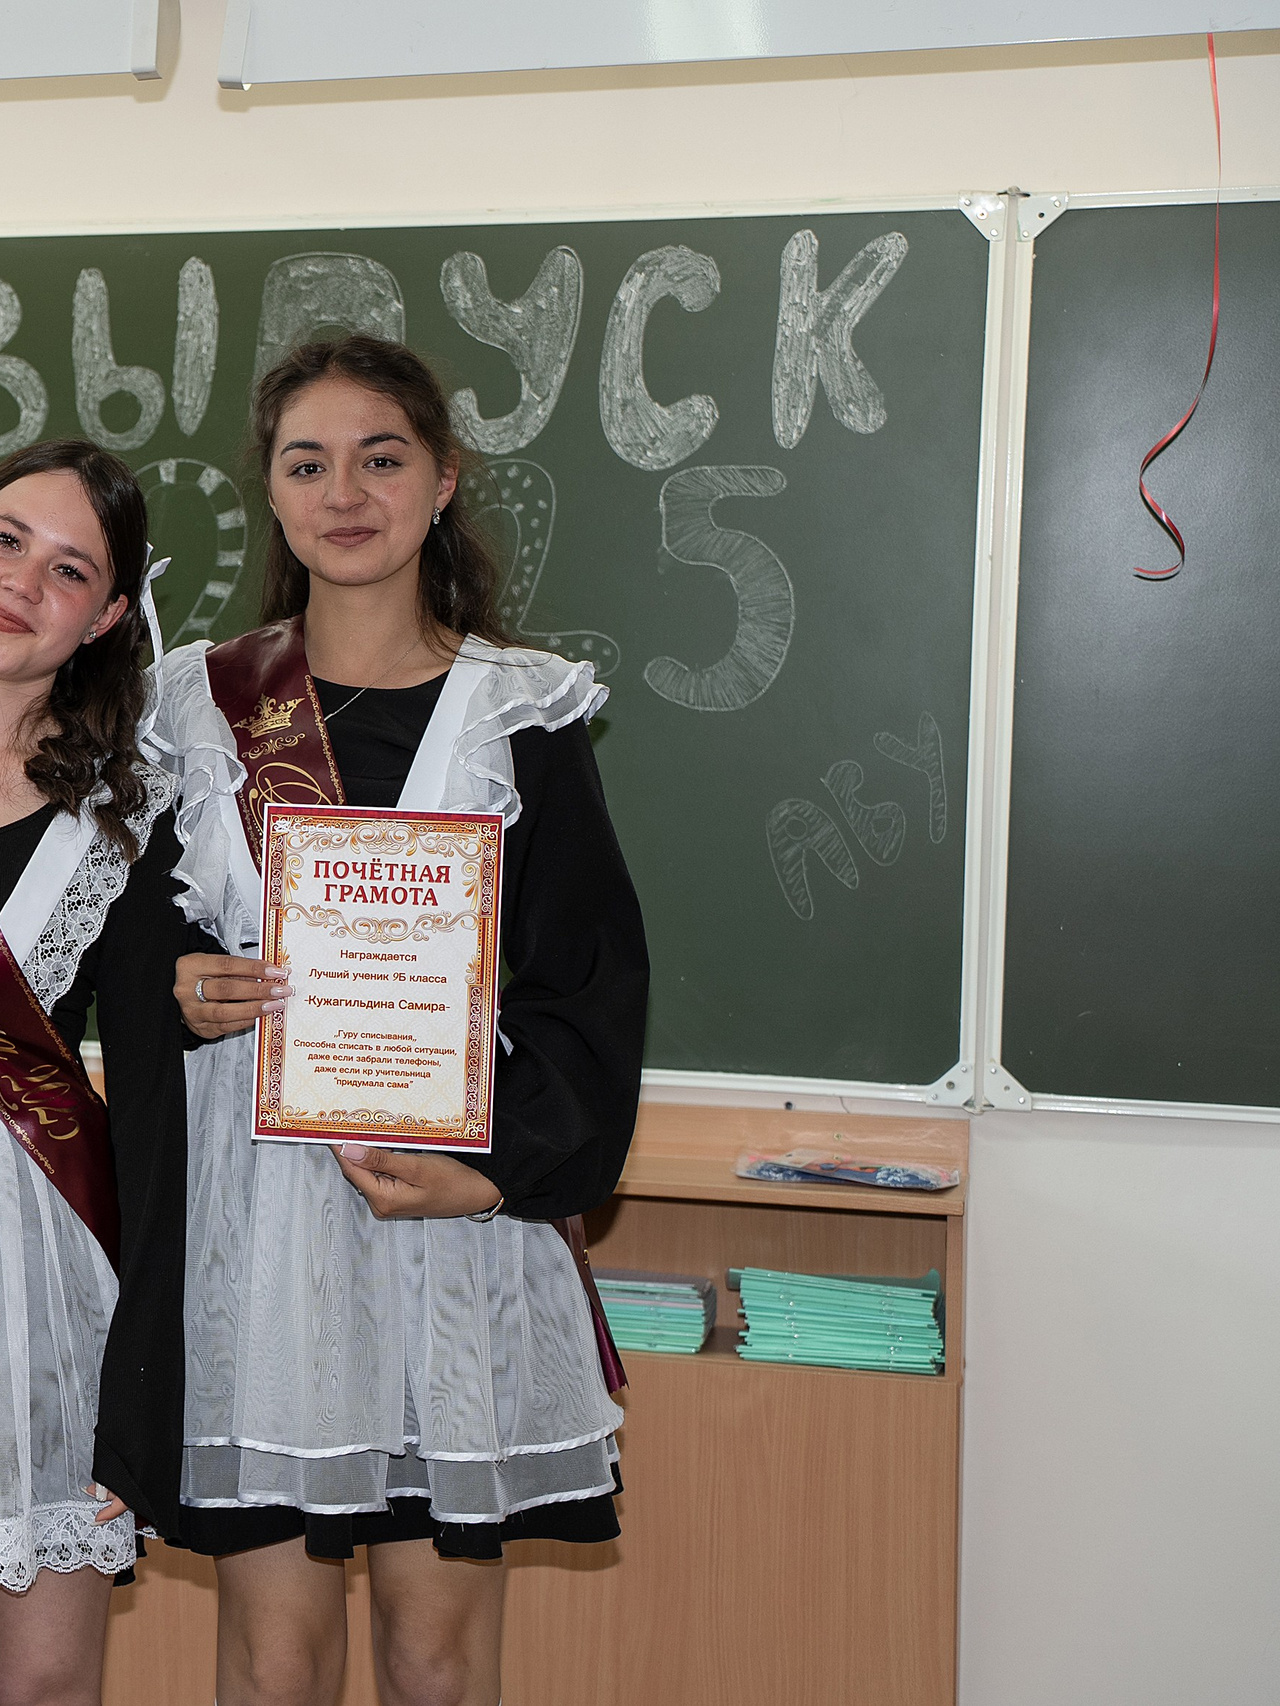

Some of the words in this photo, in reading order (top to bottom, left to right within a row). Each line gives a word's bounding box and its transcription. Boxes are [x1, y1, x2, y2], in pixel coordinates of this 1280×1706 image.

[313, 858, 451, 884] ПОЧЁТНАЯ
[324, 884, 439, 906] ГРАМОТА
[340, 949, 417, 962] Награждается
[309, 968, 350, 979] Лучший
[352, 972, 389, 982] ученик
[392, 972, 407, 982] 9Б
[409, 974, 447, 984] класса
[304, 995, 395, 1009] -Кужагильдина
[398, 999, 451, 1013] Самира-
[293, 1039, 336, 1050] Способна
[338, 1043, 373, 1052] списать
[383, 1044, 412, 1053] любой
[414, 1047, 458, 1056] ситуации,
[308, 1053, 330, 1061] даже
[355, 1054, 392, 1065] забрали
[395, 1057, 442, 1067] телефоны,
[314, 1066, 337, 1074] даже
[339, 1067, 360, 1075] если
[362, 1069, 373, 1077] кр
[375, 1070, 431, 1079] учительница
